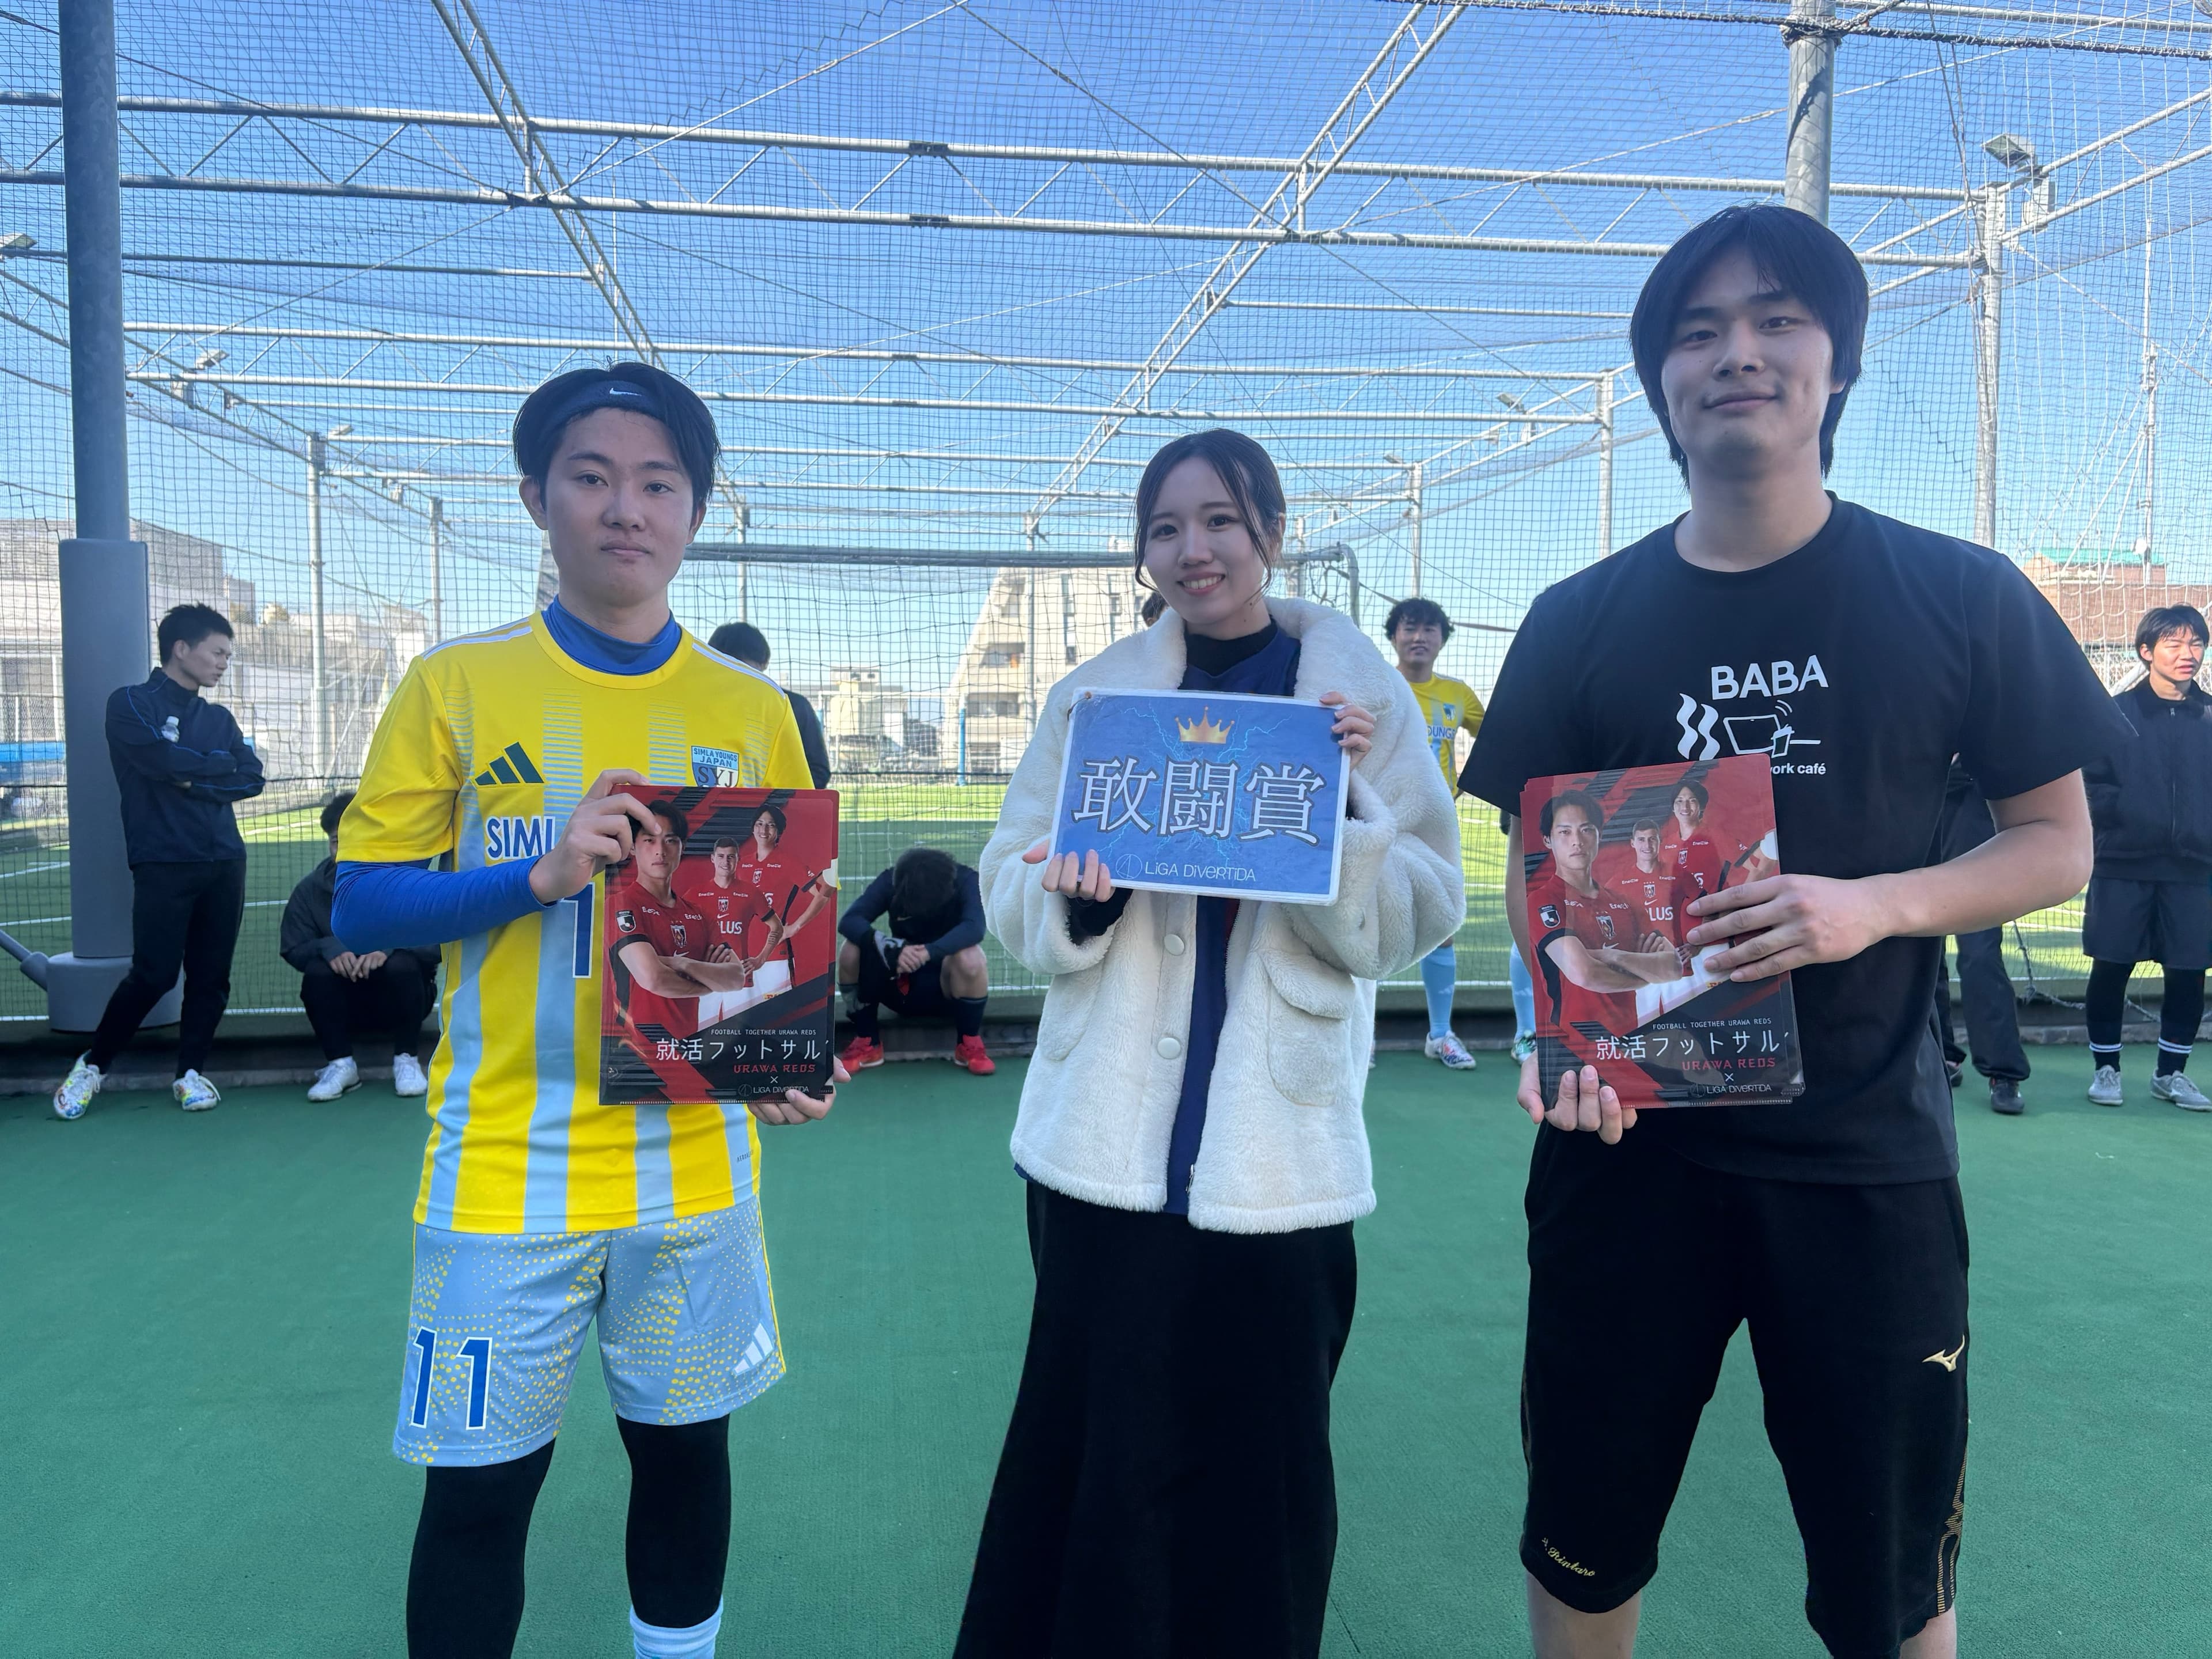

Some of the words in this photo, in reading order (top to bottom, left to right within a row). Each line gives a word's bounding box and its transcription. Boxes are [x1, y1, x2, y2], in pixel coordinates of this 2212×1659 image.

[1711, 655, 1829, 700] BABA
[694, 748, 714, 757] SIMLA
[715, 751, 737, 762] YOUNGS
[700, 756, 732, 767] JAPAN
[1797, 763, 1826, 775] café
[698, 766, 734, 787] SYJ
[1073, 756, 1326, 846] 敢闘賞
[1645, 907, 1673, 921] LUS
[717, 921, 742, 934] LUS
[656, 1037, 821, 1061] 就活フットサル
[1595, 1029, 1780, 1060] 就活フットサル
[734, 1065, 778, 1074] URAWA
[783, 1064, 816, 1073] REDS
[1681, 1060, 1732, 1071] URAWA
[1738, 1058, 1776, 1069] REDS
[411, 1326, 493, 1430] 11
